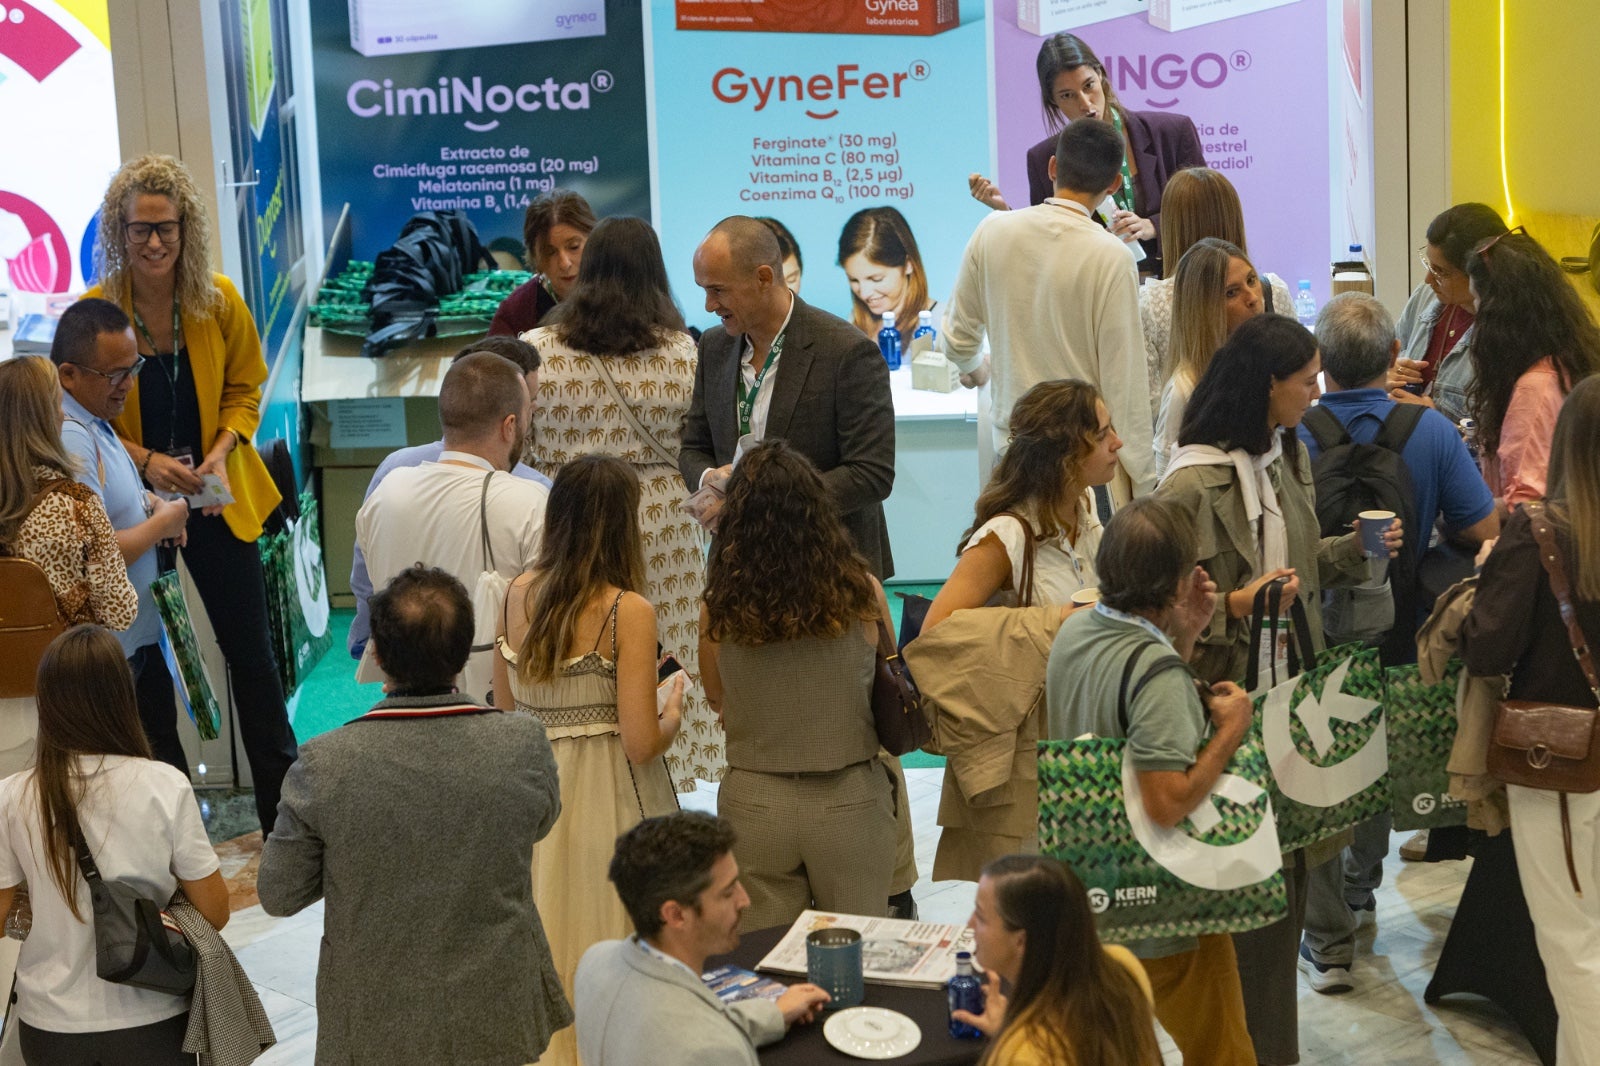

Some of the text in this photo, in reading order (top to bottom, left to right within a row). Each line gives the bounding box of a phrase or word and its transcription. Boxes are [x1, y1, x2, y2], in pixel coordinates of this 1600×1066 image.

[865, 0, 919, 15] Gynea
[555, 12, 597, 29] gynea
[865, 16, 919, 26] laboratorios
[1104, 50, 1252, 91] INGO®
[1219, 122, 1239, 136] de
[839, 133, 863, 148] (30
[867, 131, 897, 149] mg)
[1201, 139, 1247, 154] estrel
[440, 145, 530, 160] Extracto de
[751, 149, 899, 167] Vitamina C (80 mg)
[372, 156, 598, 178] Cimicífuga racemosa (20 mg)
[749, 170, 818, 184] Vitamina
[846, 166, 874, 182] (2,5
[418, 174, 555, 193] Melatonina (1 mg)
[739, 188, 817, 202] Coenzima
[848, 184, 880, 200] (100
[884, 183, 914, 200] mg)
[411, 196, 481, 211] Vitamina
[504, 193, 530, 209] (1,4
[1115, 885, 1157, 901] KERN
